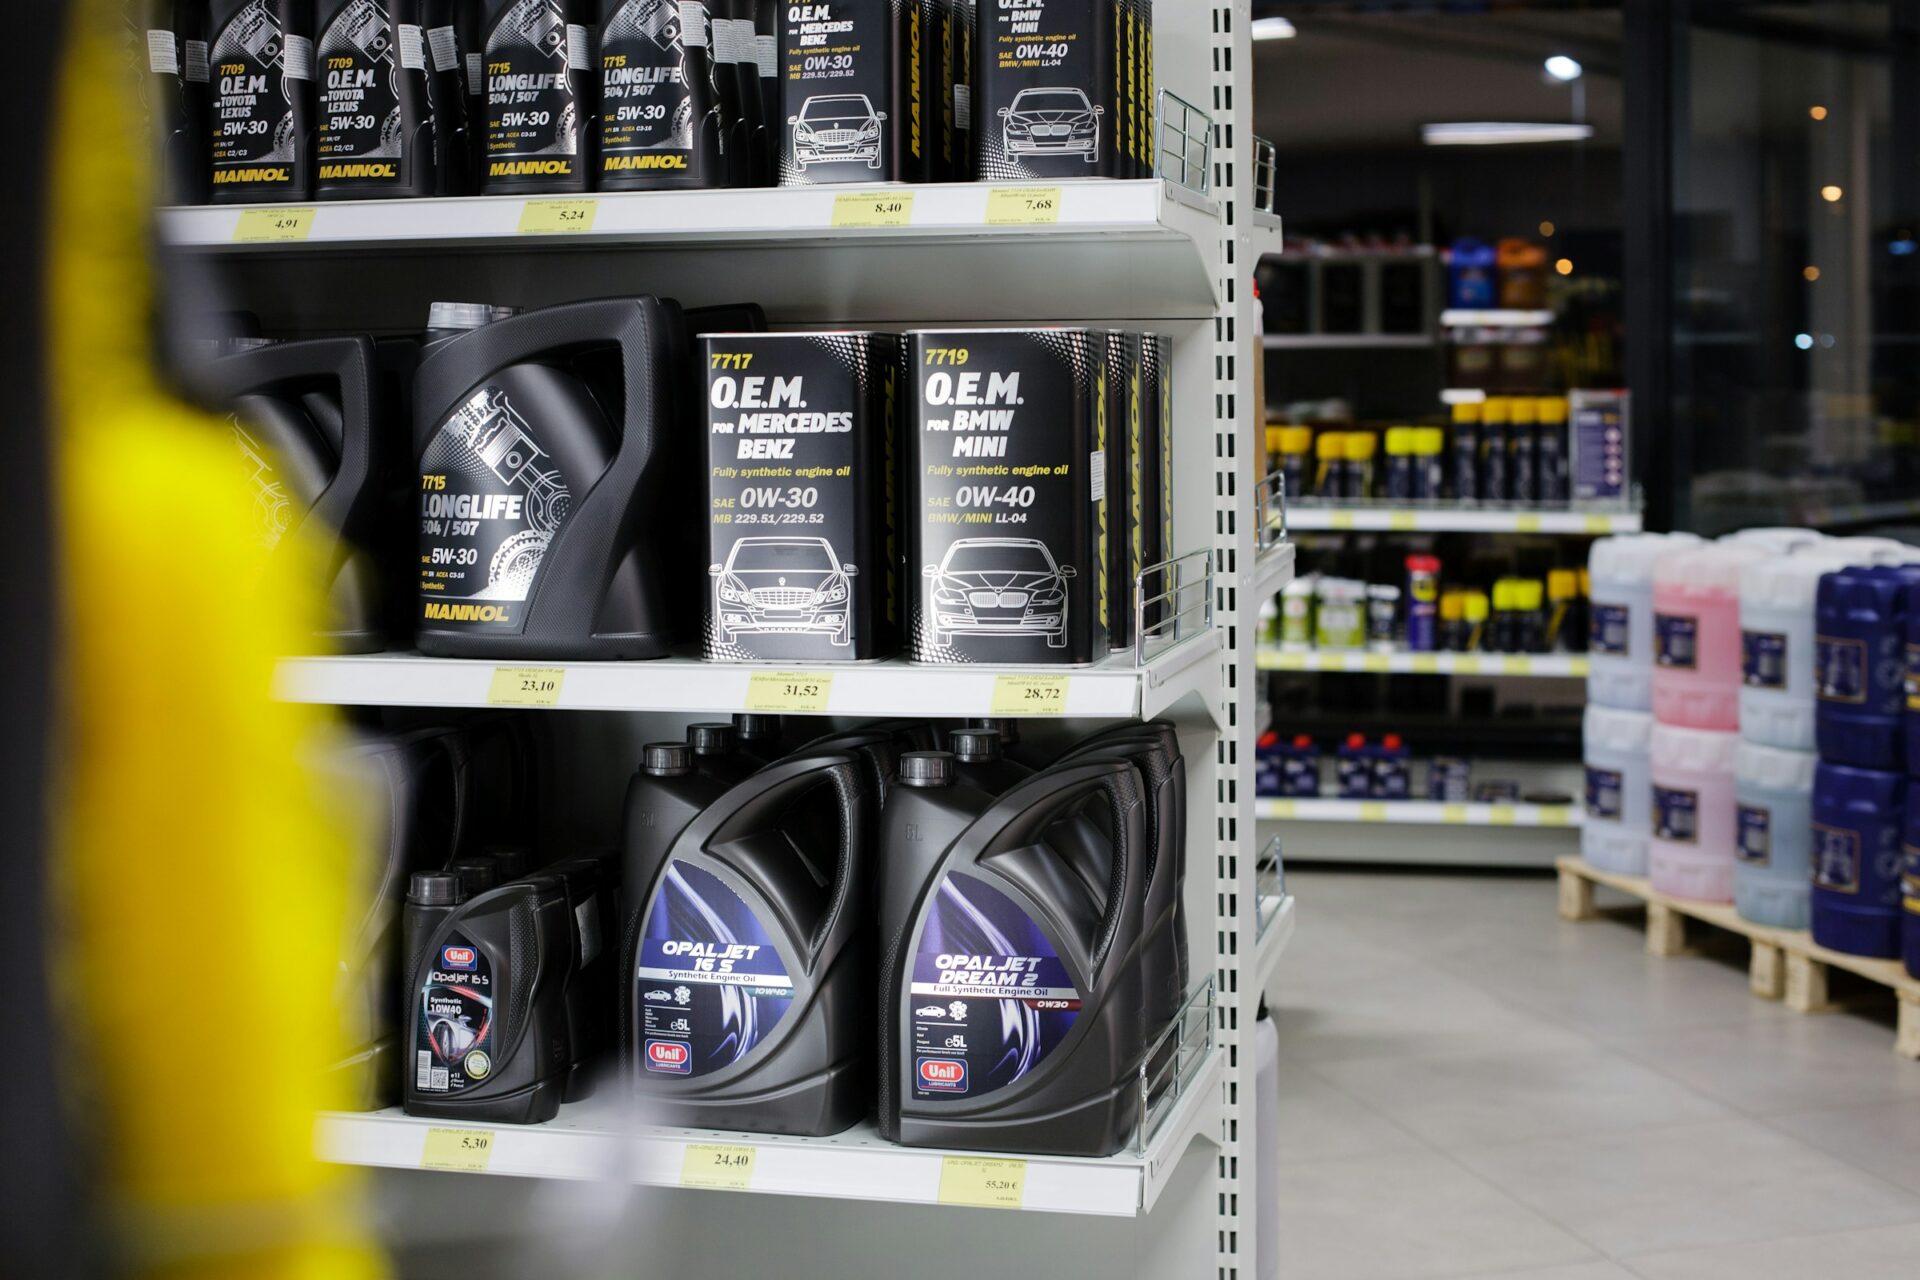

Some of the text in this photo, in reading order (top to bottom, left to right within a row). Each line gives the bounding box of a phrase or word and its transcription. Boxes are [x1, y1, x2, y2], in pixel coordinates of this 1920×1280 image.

[788, 5, 831, 22] O.E.M.
[1011, 10, 1042, 21] BMW
[800, 21, 853, 34] MERCEDES
[1011, 22, 1038, 33] MINI
[800, 34, 827, 46] BENZ
[1015, 35, 1043, 43] synthetic
[804, 47, 830, 55] synthetic
[1016, 43, 1068, 59] 0W-40
[329, 58, 353, 69] 7709
[489, 63, 510, 74] 7715
[604, 56, 626, 67] 7715
[805, 55, 852, 70] 0W-30
[1000, 60, 1040, 68] BMW/MINI
[221, 64, 245, 75] 7709
[604, 67, 680, 86] LONGLIFE
[221, 75, 268, 95] O.E.M.
[328, 69, 376, 89] O.E.M.
[489, 74, 565, 92] LONGLIFE
[911, 3, 920, 159] MANNOL
[328, 89, 364, 101] TOYOTA
[489, 94, 507, 104] 504
[516, 91, 539, 103] 507
[604, 87, 623, 98] 504
[632, 85, 655, 96] 507
[221, 95, 256, 107] TOYOTA
[328, 101, 359, 113] LEXUS
[221, 107, 251, 119] LEXUS
[502, 111, 549, 126] 5W-30
[617, 105, 665, 120] 5W-30
[223, 121, 267, 135] 5W-30
[330, 115, 374, 130] 5W-30
[490, 142, 516, 150] Synthetic
[605, 136, 631, 144] Synthetic
[490, 161, 571, 176] MANNOL
[604, 155, 687, 170] MANNOL
[214, 168, 289, 183] MANNOL
[320, 164, 395, 178] MANNOL
[711, 354, 752, 369] 7717
[925, 349, 968, 366] 7719
[711, 376, 807, 409] O.E.M.
[925, 372, 1024, 406] O.E.M.
[712, 412, 853, 433] FOR MERCEDES
[927, 410, 1014, 431] FOR BMW
[737, 439, 795, 459] BENZ
[953, 436, 1008, 457] MINI
[713, 466, 850, 478] Fully synthetic engine oil
[927, 464, 1068, 476] Fully synthetic engine oil
[422, 475, 446, 490] 7715
[713, 487, 818, 508] SAE 0W-30
[928, 486, 1035, 507] SAE 0W-40
[422, 494, 523, 519] LONGLIFE
[713, 514, 824, 525] MB 229.51/229.52
[928, 513, 1027, 525] BMW/MINI LL-04
[422, 521, 441, 535] 504
[452, 521, 479, 536] 507
[432, 548, 477, 565] 5W-30
[422, 582, 445, 591] Synthetic
[425, 603, 509, 622] MANNOL
[1024, 689, 1060, 699] 28,72
[451, 951, 468, 960] Unil
[663, 941, 760, 960] OPALJET
[695, 958, 735, 973] 16 S
[936, 954, 1042, 972] OPALJET
[433, 972, 488, 984] Opaljet 16 S
[669, 970, 707, 980] Synthetic
[711, 973, 740, 982] Engine
[939, 970, 1038, 986] DREAM 2
[755, 988, 787, 996] 10W40
[953, 986, 996, 994] Synthetic
[999, 988, 1032, 996] Engine
[431, 1004, 462, 1014] 10W40
[656, 1047, 679, 1060] Unil
[929, 1065, 955, 1078] Unil
